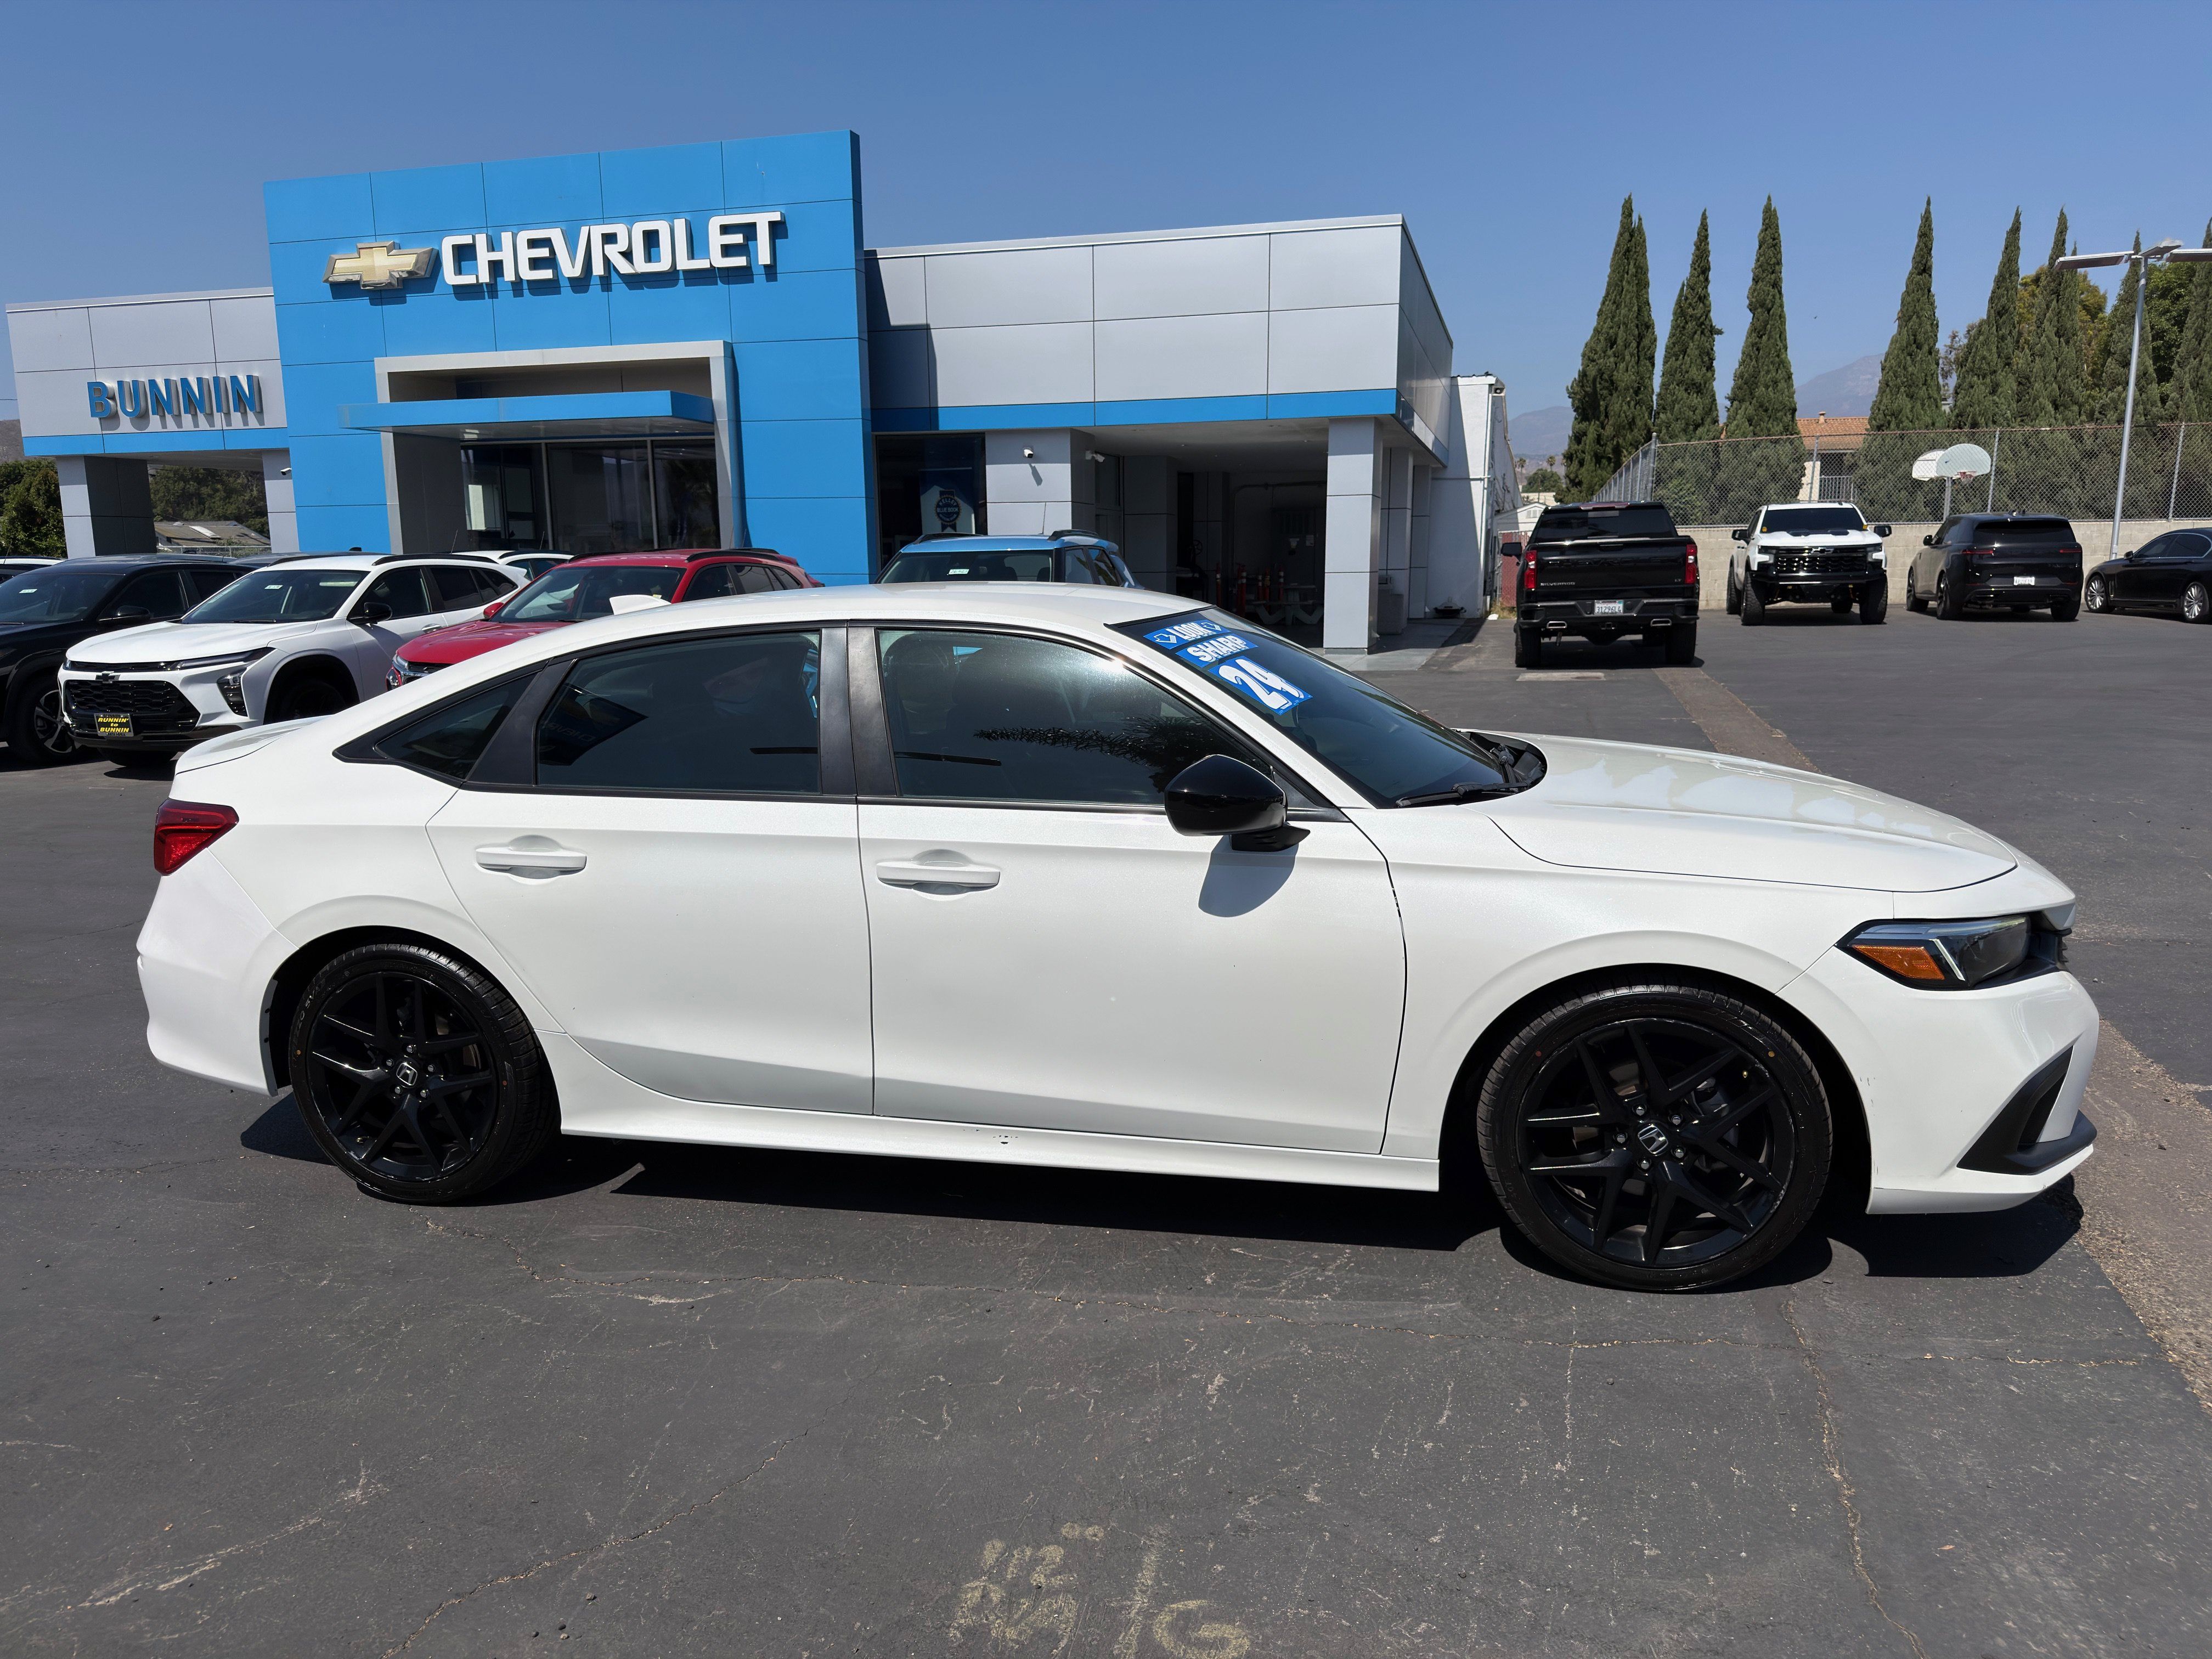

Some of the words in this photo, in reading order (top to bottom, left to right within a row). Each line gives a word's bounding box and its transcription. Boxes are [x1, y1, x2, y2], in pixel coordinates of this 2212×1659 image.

[441, 211, 785, 285] CHEVROLET
[87, 374, 263, 419] BUNNIN
[939, 498, 957, 506] KELLEY
[1165, 622, 1216, 641] LOOK
[1187, 635, 1249, 662] SHARP
[1218, 659, 1305, 709] 24
